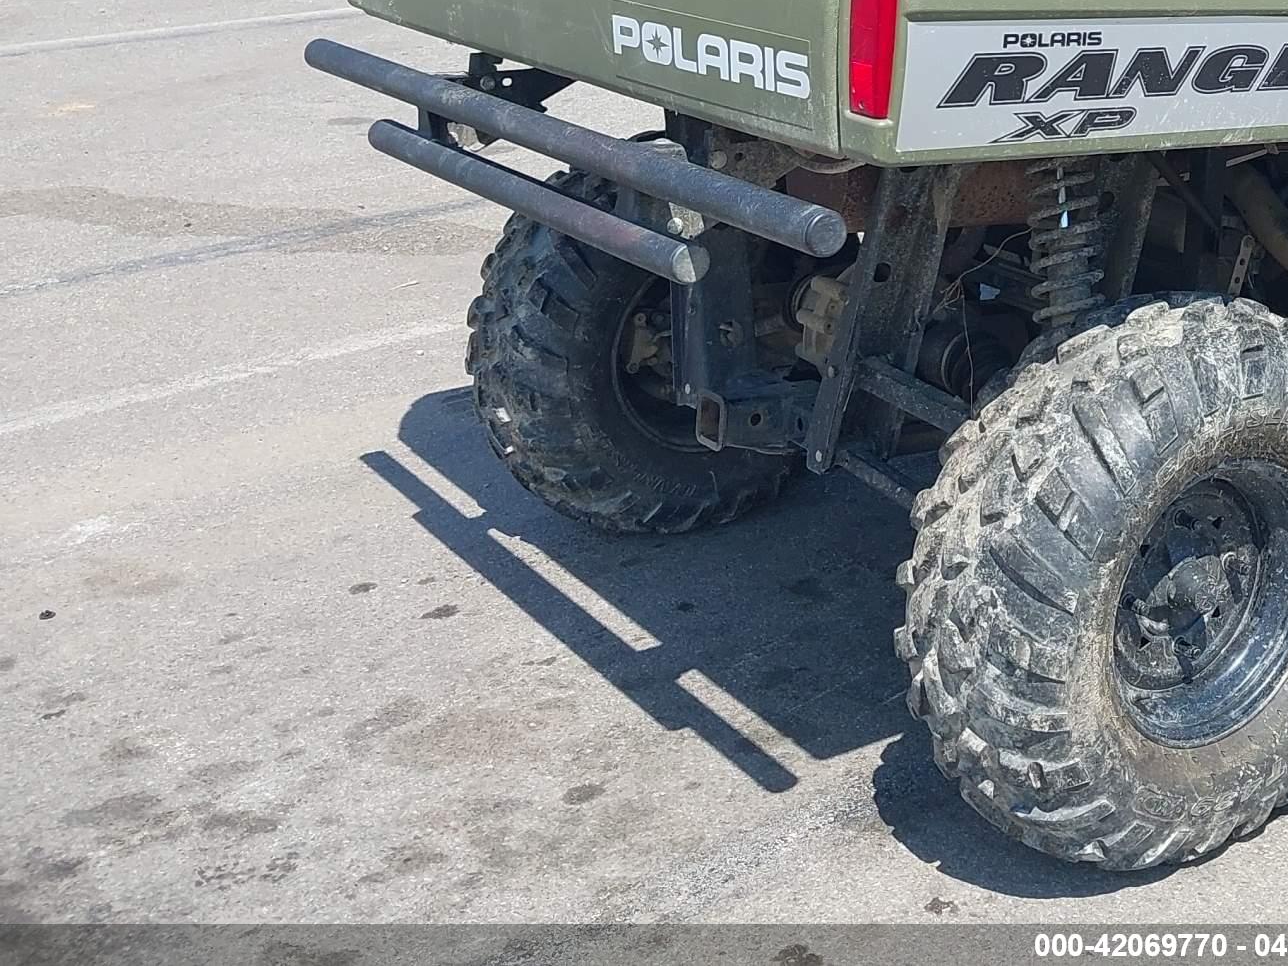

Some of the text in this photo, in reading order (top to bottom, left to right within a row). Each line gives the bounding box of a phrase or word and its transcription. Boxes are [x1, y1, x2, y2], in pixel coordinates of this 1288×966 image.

[612, 15, 810, 99] POLARIS
[1003, 32, 1102, 49] POLARIS
[988, 106, 1137, 144] XP
